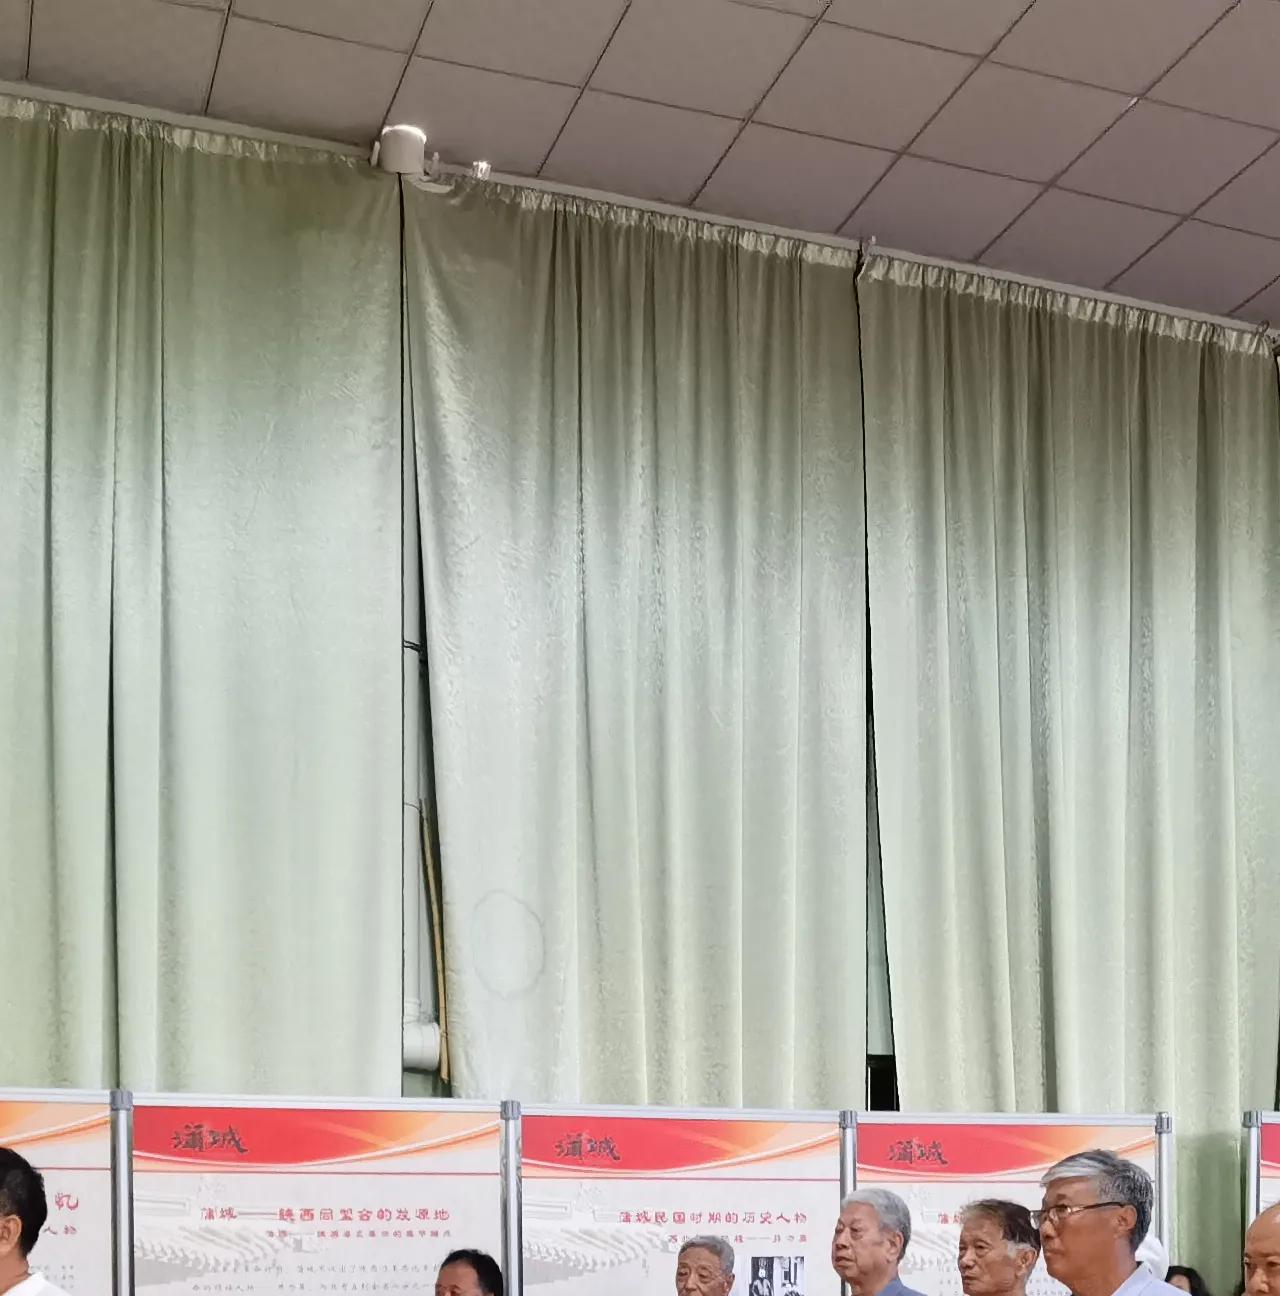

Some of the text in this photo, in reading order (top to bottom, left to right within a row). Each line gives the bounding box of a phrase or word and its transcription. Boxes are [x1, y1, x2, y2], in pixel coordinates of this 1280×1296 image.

[172, 1124, 248, 1154] 蒲城
[620, 1211, 808, 1225] 蒲城民国时期的历史人物
